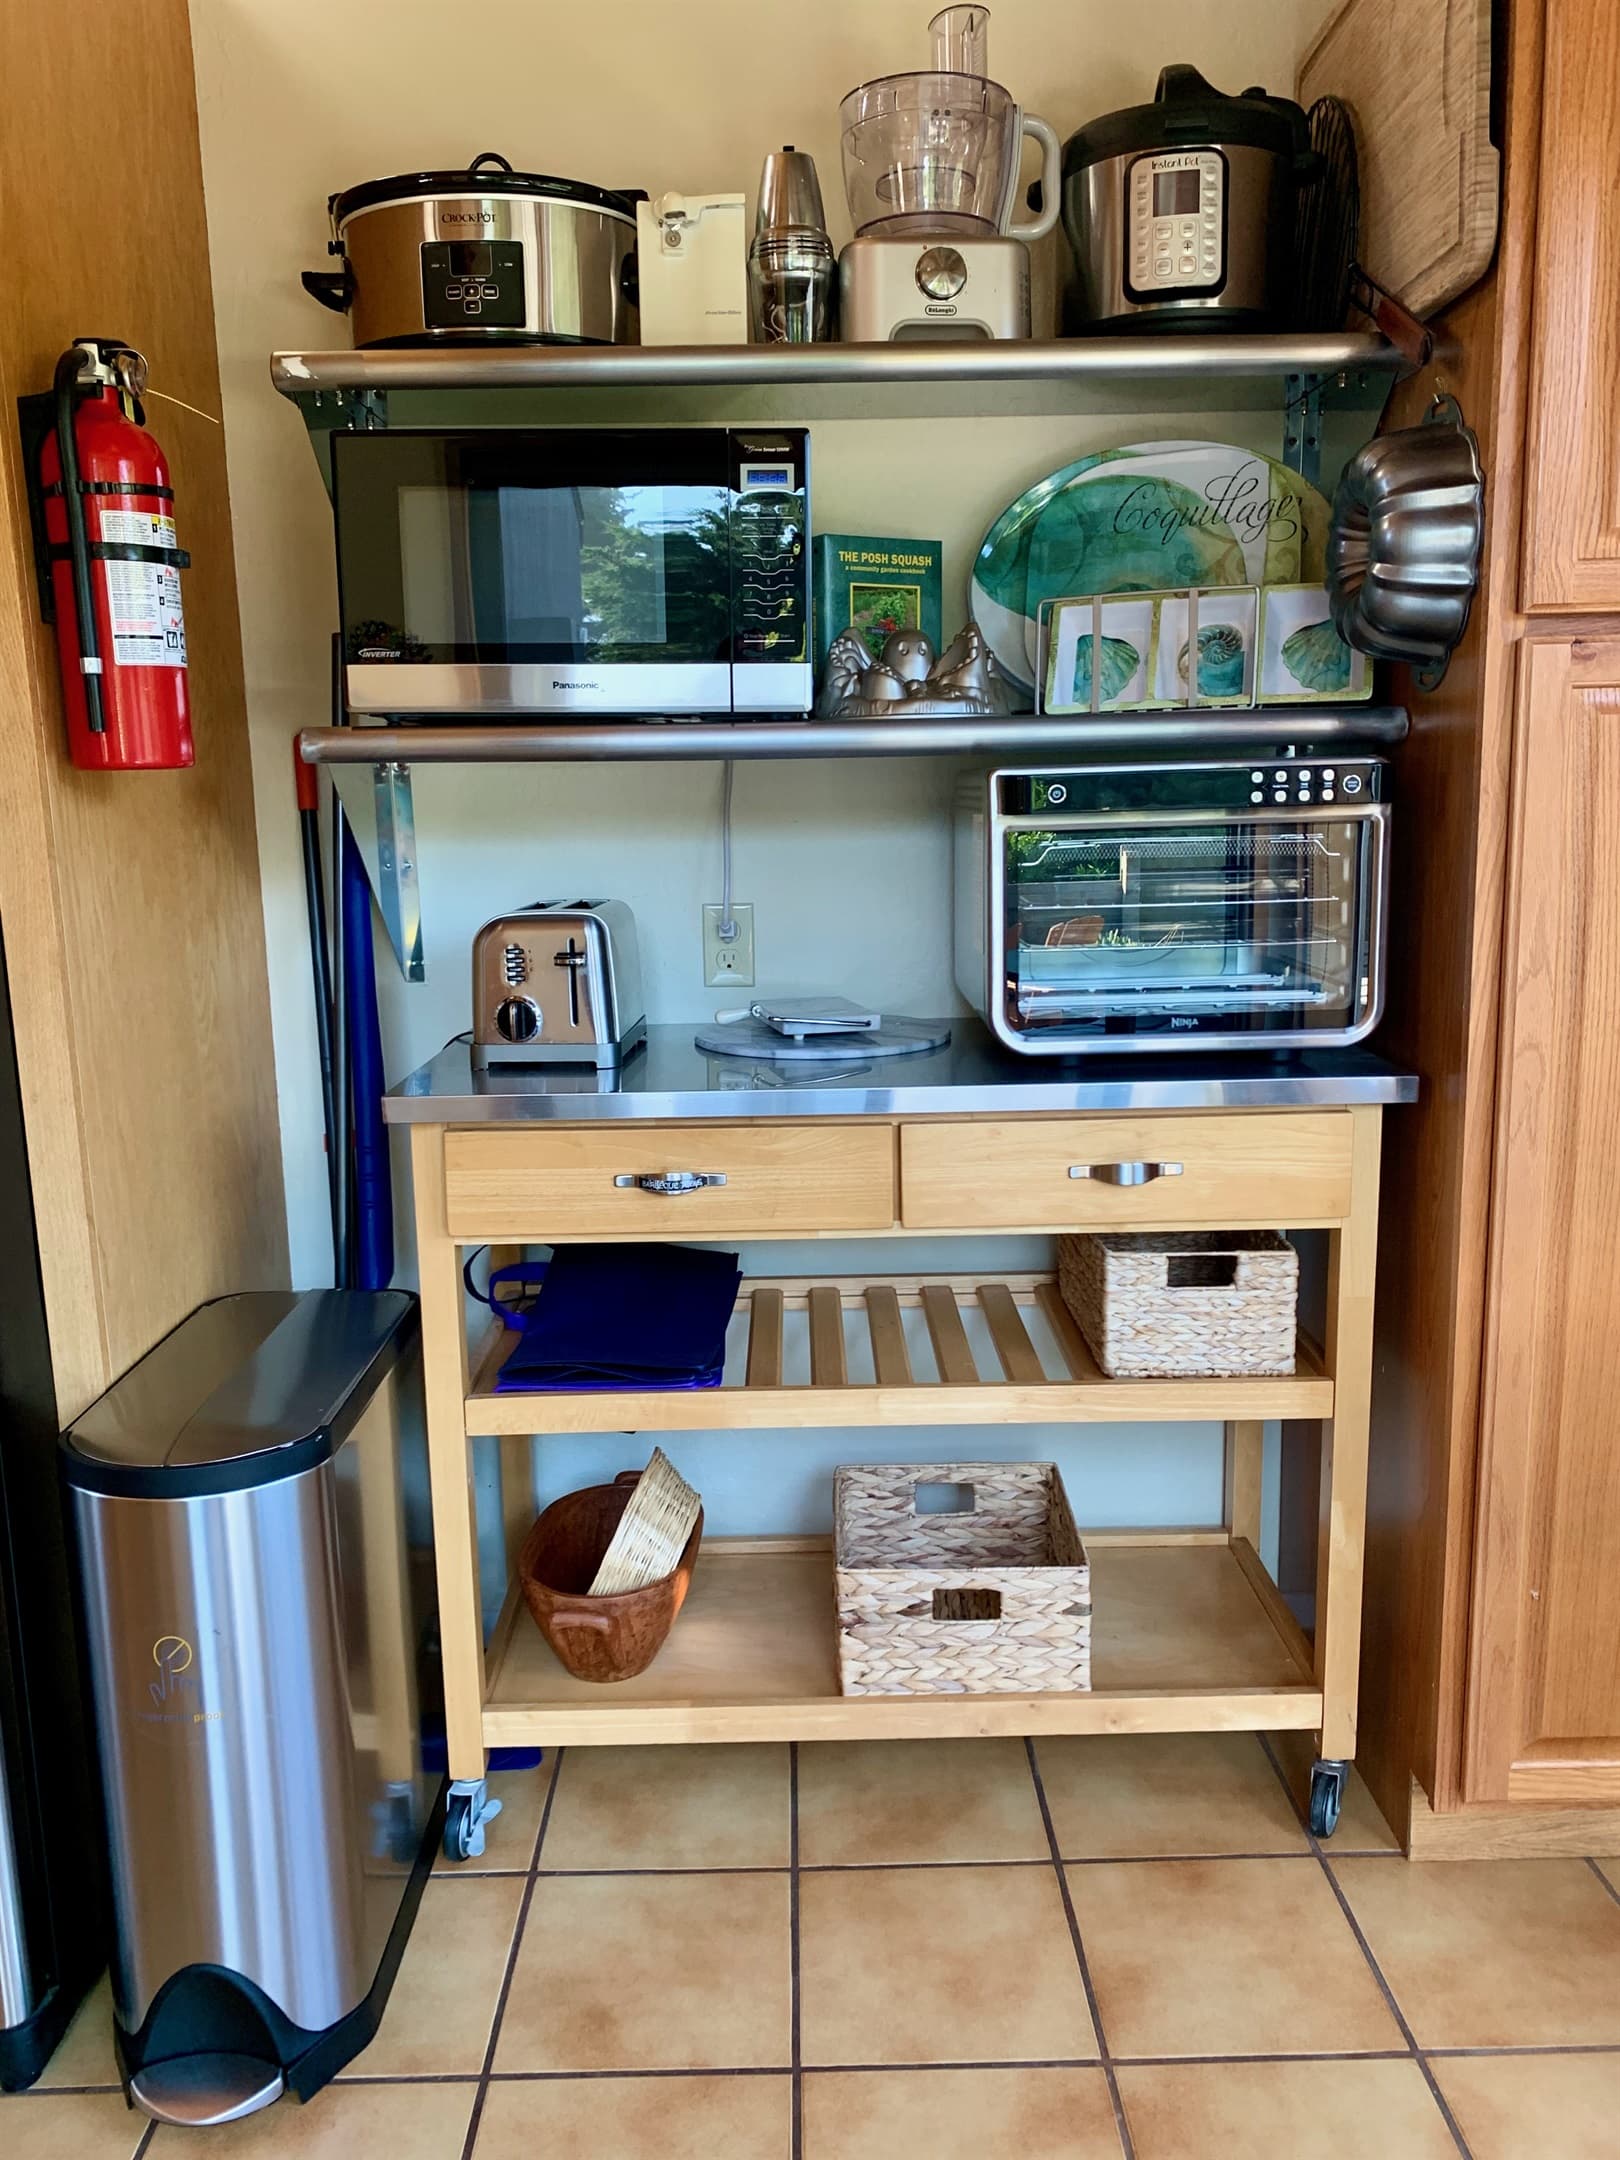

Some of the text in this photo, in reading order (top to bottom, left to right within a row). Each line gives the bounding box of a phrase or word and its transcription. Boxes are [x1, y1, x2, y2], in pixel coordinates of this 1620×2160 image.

[1151, 156, 1199, 170] Instant Pot
[838, 550, 933, 567] THE POSH SQUASH
[361, 650, 401, 658] INVERTER
[552, 681, 599, 689] Panasonic
[1171, 1016, 1199, 1029] NINJA
